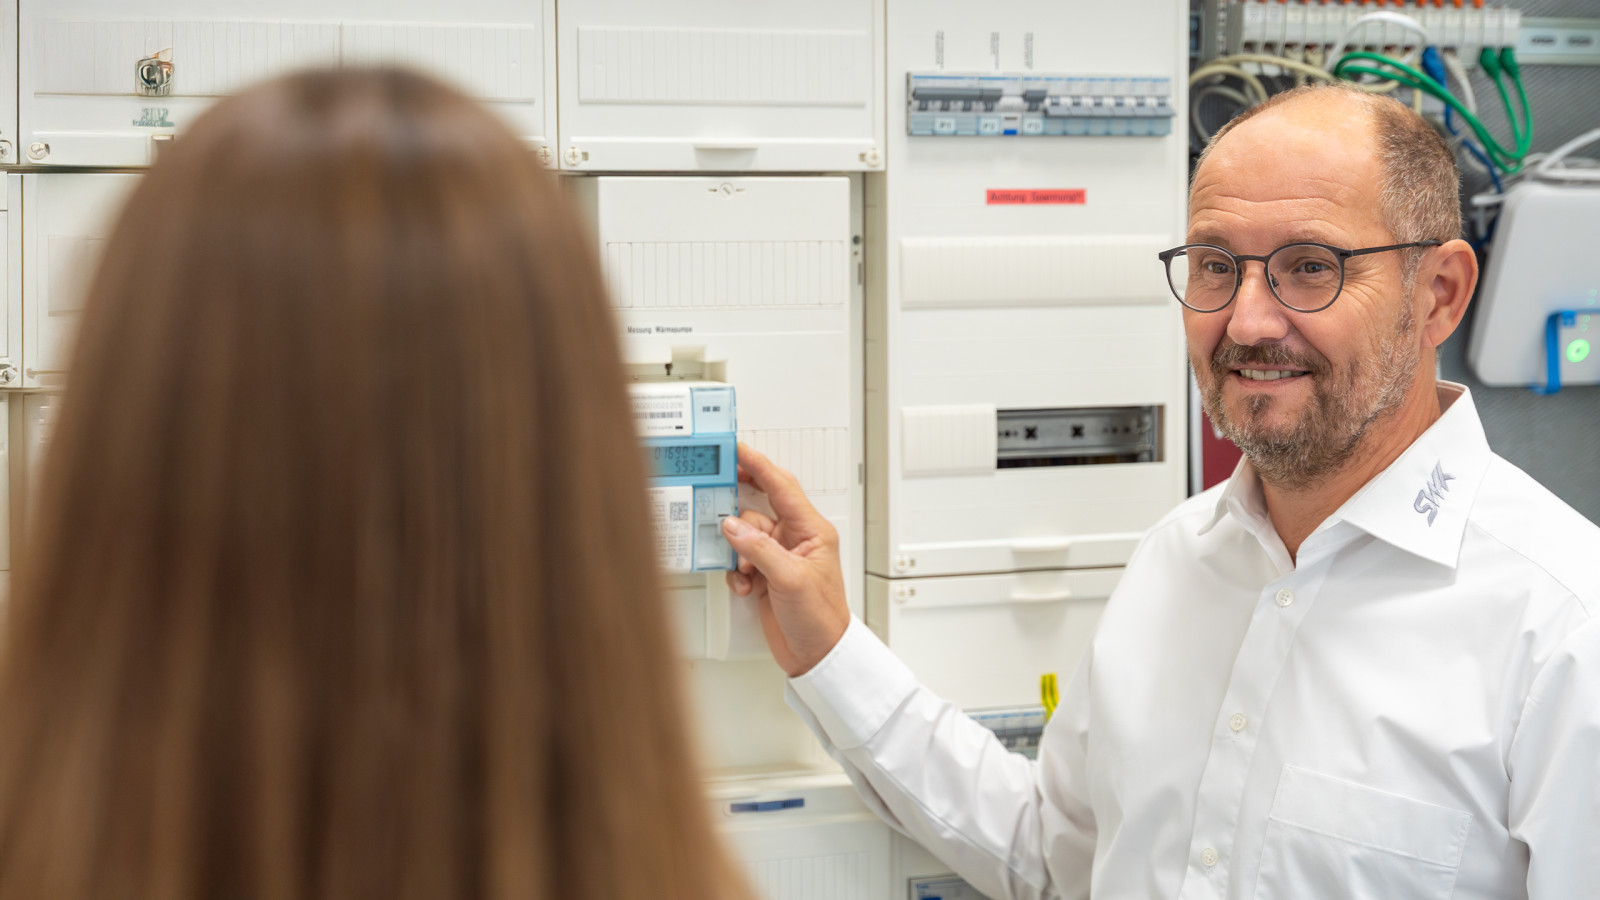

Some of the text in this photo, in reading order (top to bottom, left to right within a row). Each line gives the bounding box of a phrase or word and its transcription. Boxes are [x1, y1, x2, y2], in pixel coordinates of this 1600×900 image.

[991, 191, 1026, 203] Achtung
[627, 325, 693, 334] Messung Wärmepumpe
[1413, 459, 1457, 528] SWK
